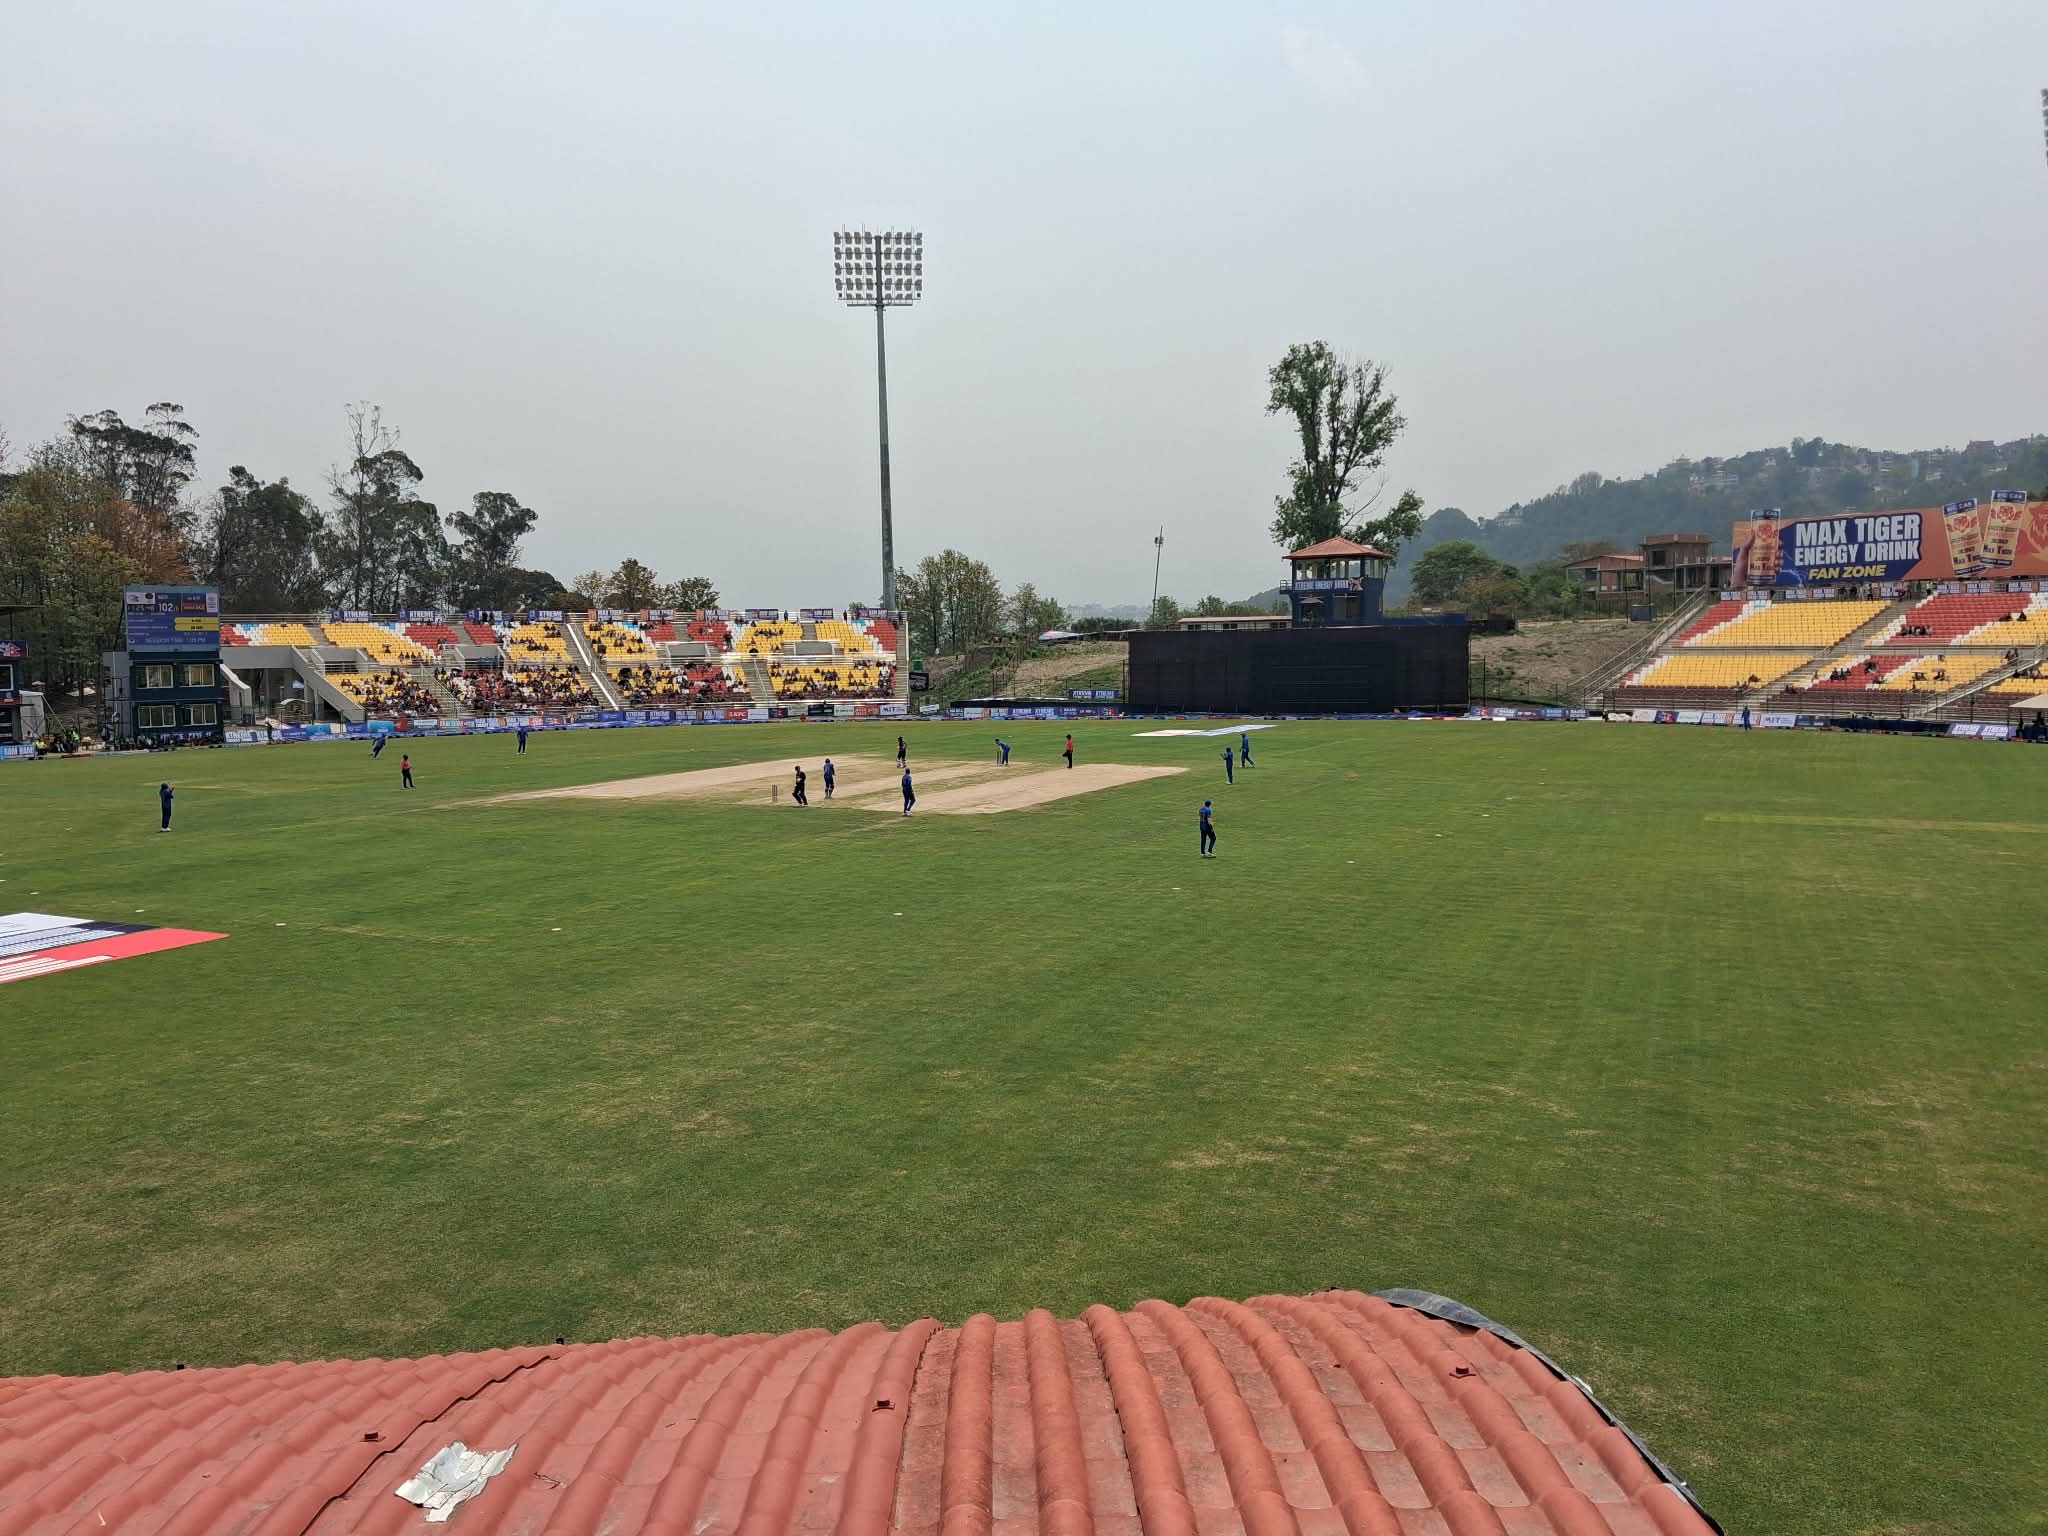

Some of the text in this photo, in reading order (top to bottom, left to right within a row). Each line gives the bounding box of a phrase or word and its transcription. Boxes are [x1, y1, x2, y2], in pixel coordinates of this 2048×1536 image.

[1795, 514, 1921, 546] MAX TIGER
[1794, 540, 1921, 566] ENERGY DRINK
[1808, 564, 1887, 580] FAN ZONE
[158, 602, 174, 612] 102
